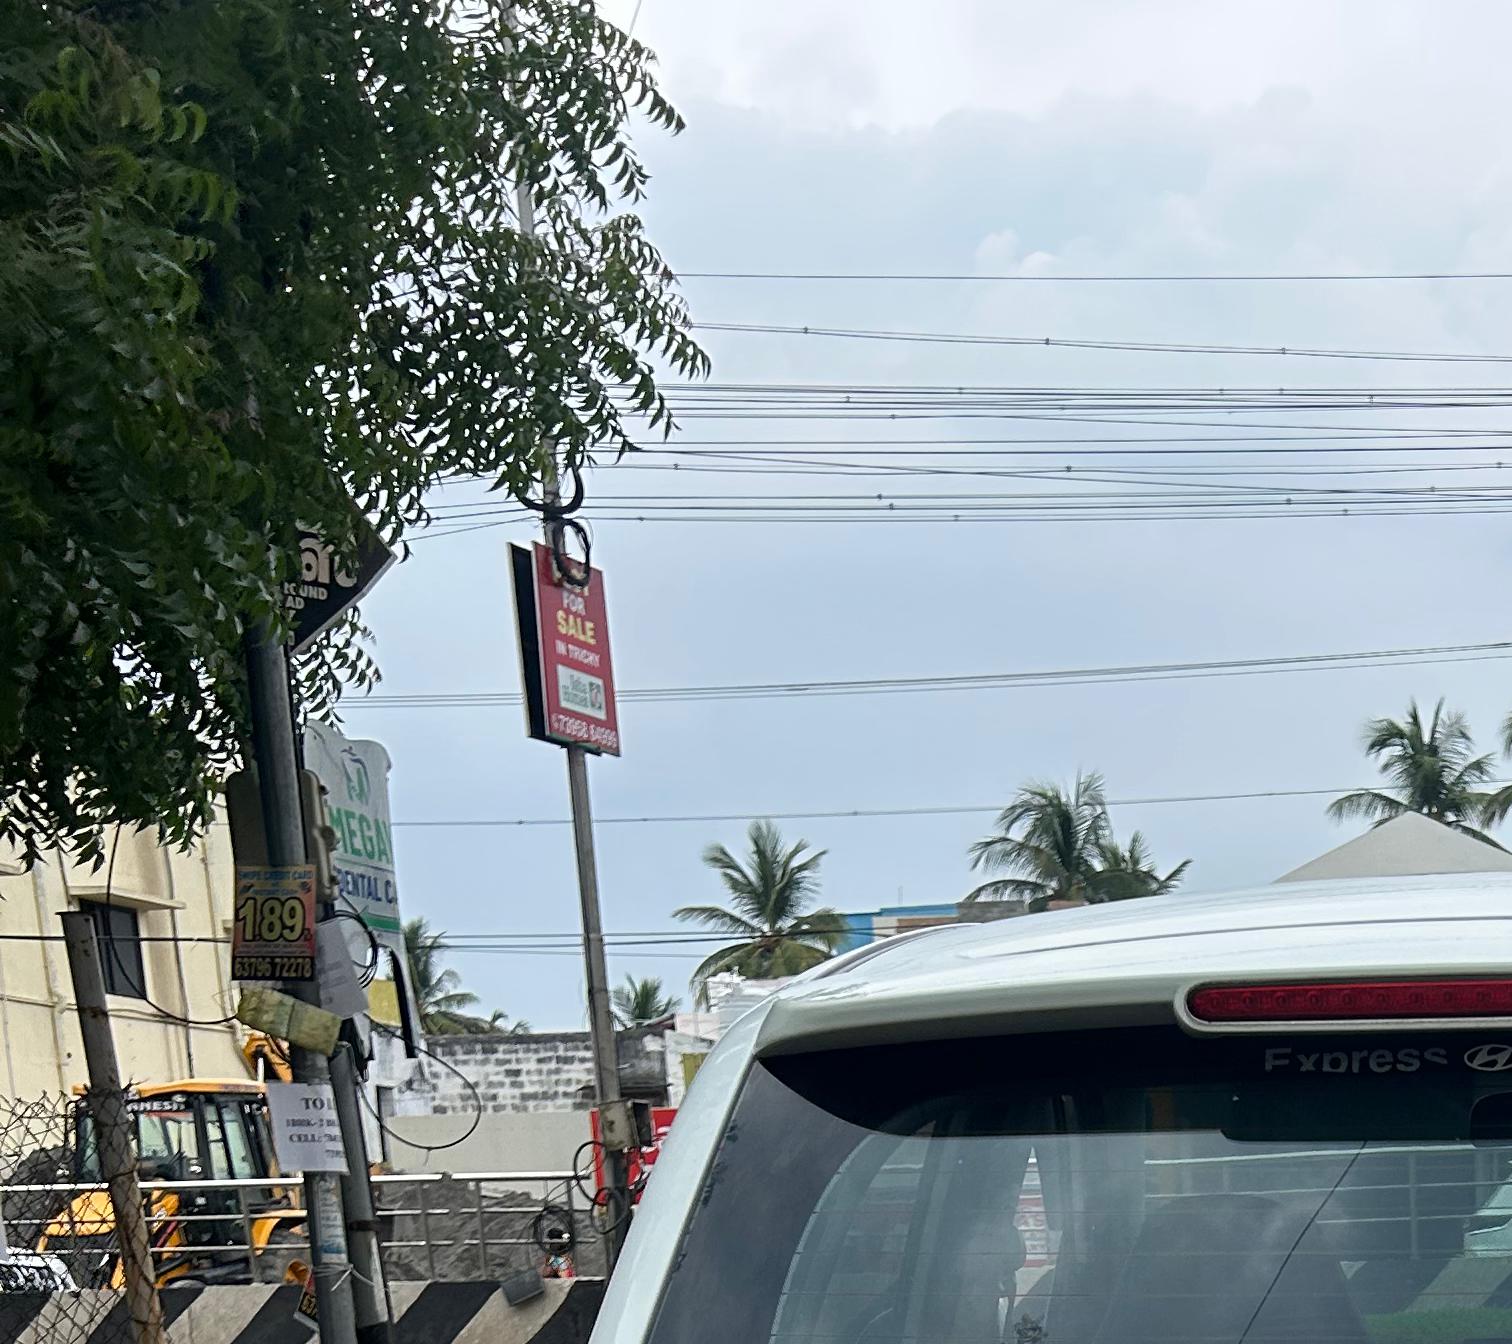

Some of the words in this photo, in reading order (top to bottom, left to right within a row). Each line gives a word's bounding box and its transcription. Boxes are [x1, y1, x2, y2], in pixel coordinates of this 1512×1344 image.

[556, 609, 597, 645] SALE
[1264, 1047, 1448, 1074] Express
[300, 1097, 325, 1111] TO
